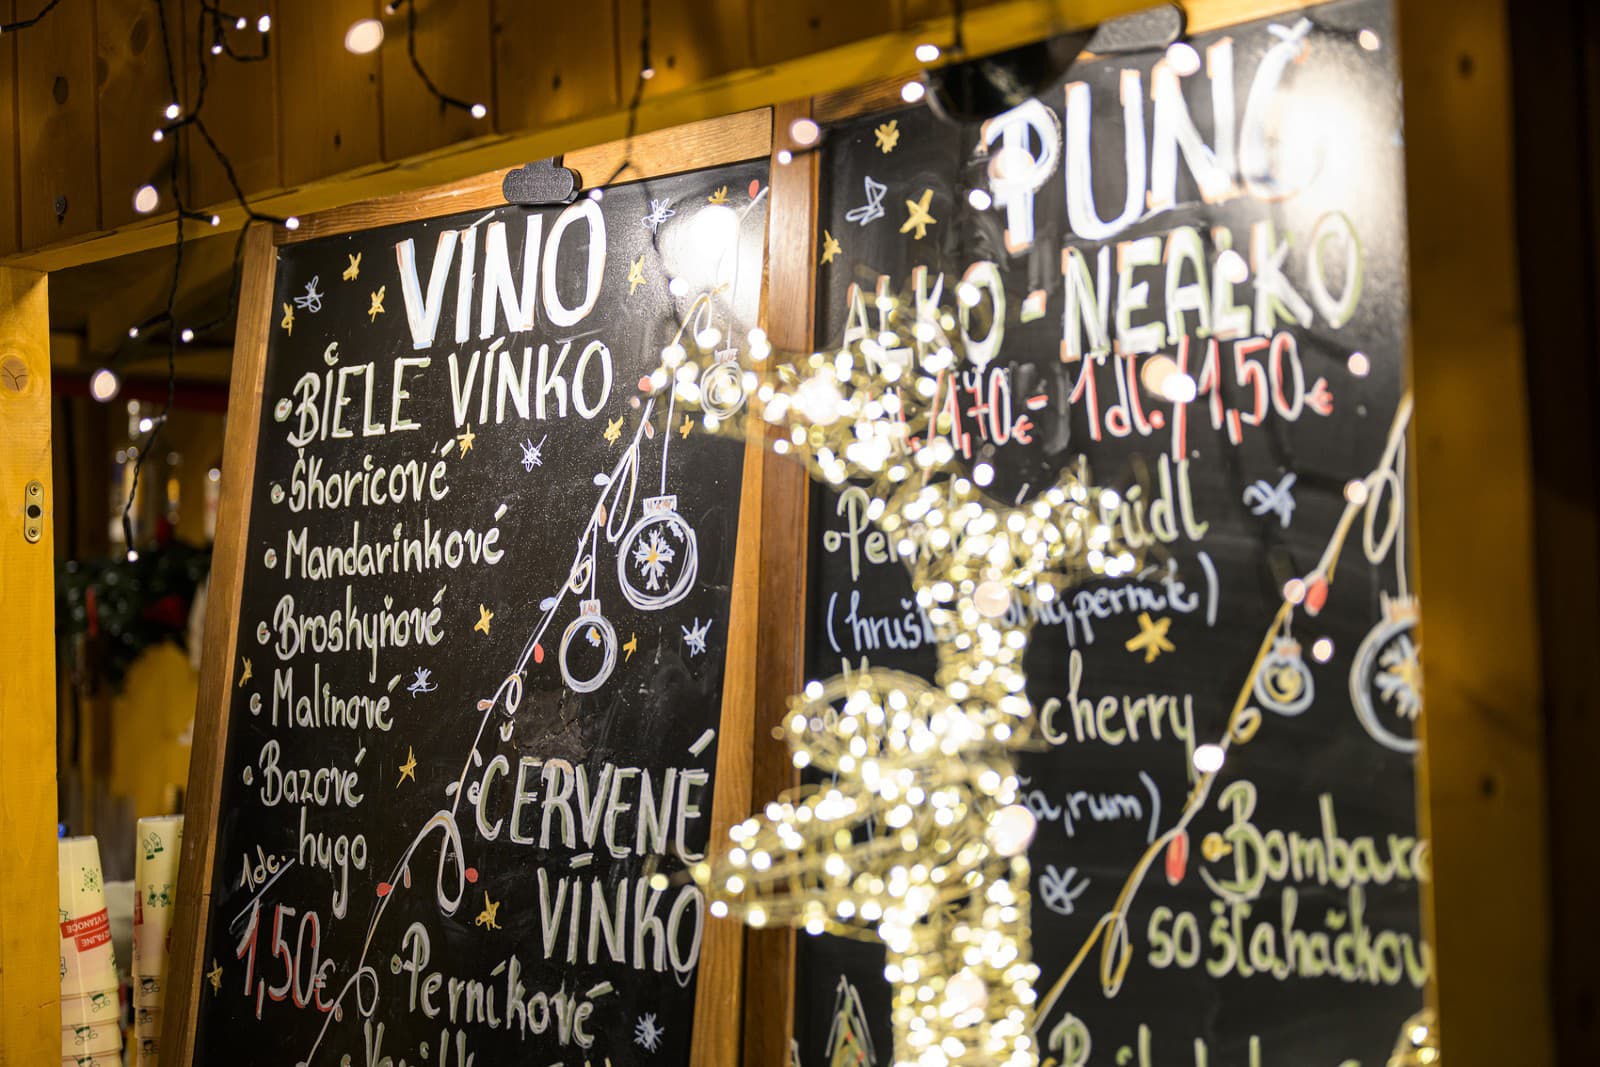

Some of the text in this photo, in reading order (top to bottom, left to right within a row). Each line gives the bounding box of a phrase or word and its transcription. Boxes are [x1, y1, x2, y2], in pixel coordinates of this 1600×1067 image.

[396, 200, 607, 349] VÍNO
[845, 262, 1006, 376] ALKO
[1060, 210, 1362, 364] NEALKO
[287, 338, 613, 448] BIELE VÍNKO
[287, 440, 455, 512] Škoricové
[284, 504, 508, 580] Mandarinkové
[272, 586, 446, 682] Broskyňové
[272, 664, 401, 730] Malinové
[1040, 648, 1200, 782] cherry
[259, 740, 366, 807] Bazové
[476, 720, 714, 861] ČERVENÉ
[299, 808, 367, 919] hugo
[536, 852, 704, 986] VÍNKO
[236, 898, 336, 1020] 1,50€
[401, 921, 613, 1048] Perníkové
